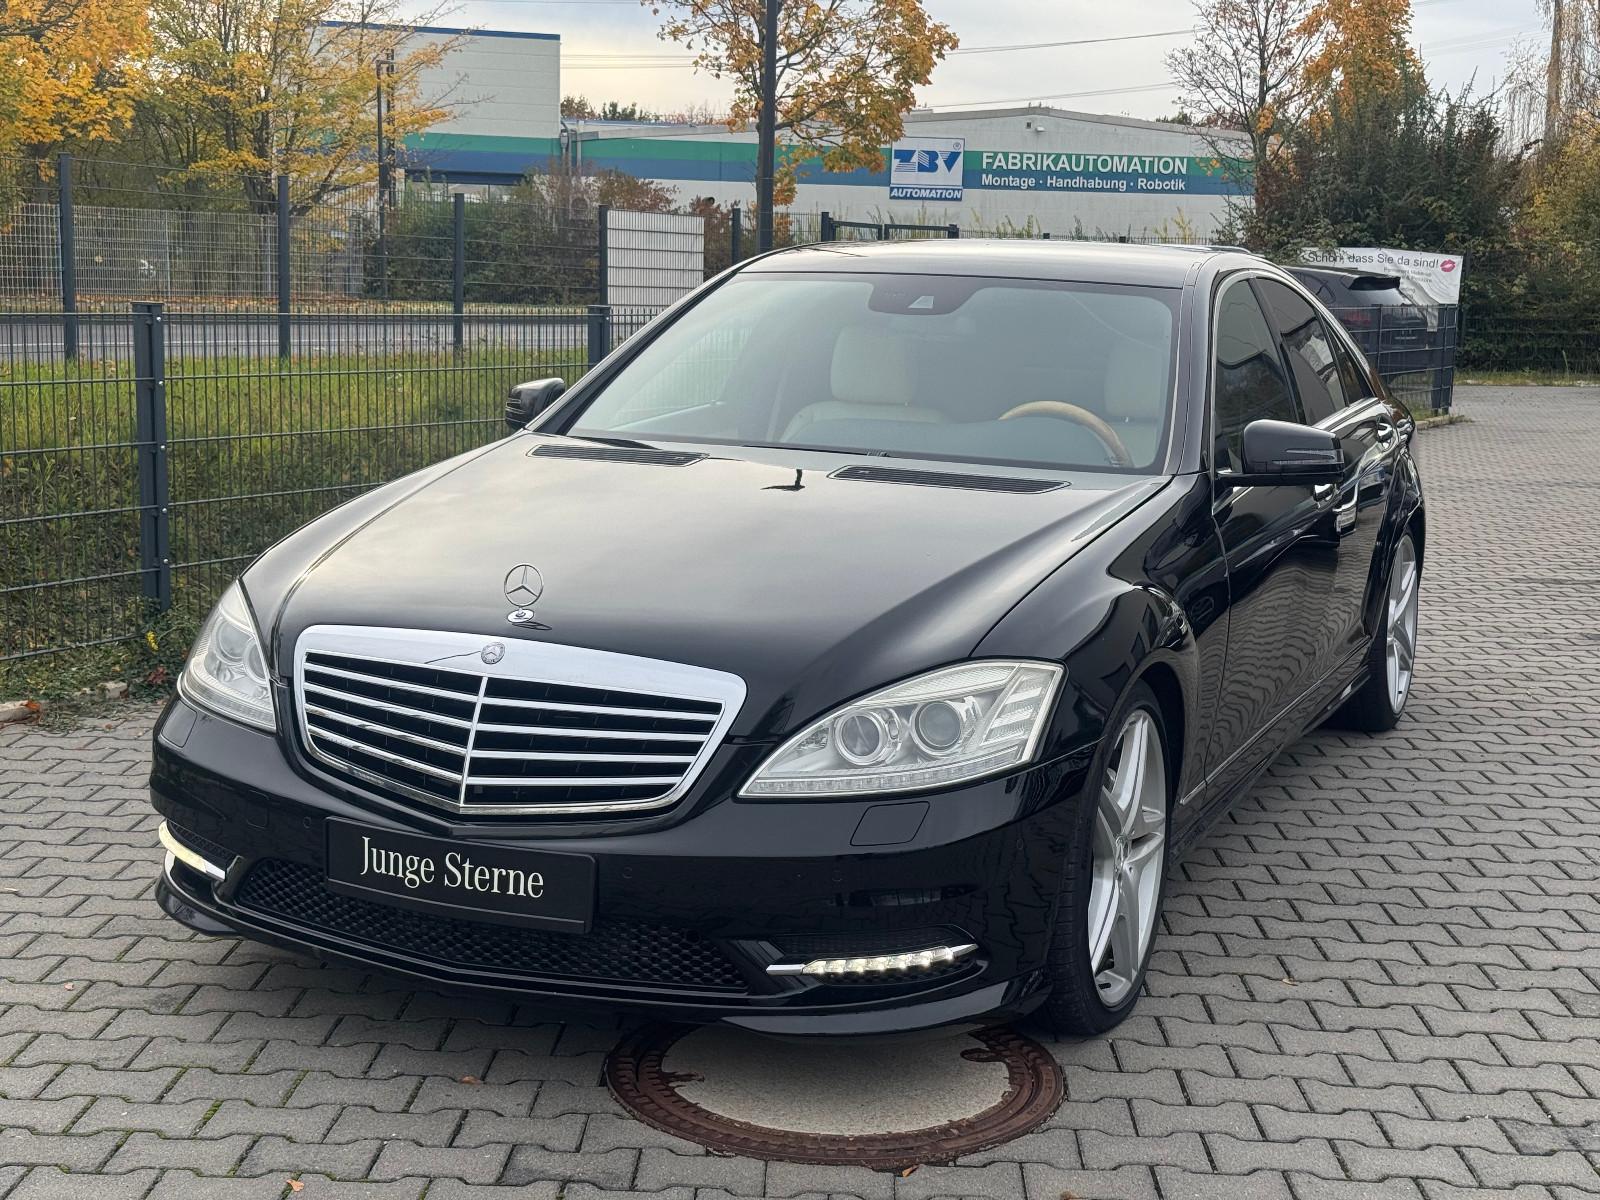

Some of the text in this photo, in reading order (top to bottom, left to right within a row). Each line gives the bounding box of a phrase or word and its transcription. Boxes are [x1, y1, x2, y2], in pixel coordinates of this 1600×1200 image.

[894, 150, 962, 173] ZBV
[981, 152, 1187, 175] FABRIKAUTOMATION
[981, 174, 1186, 191] Montage Handhabung Robotik
[890, 188, 962, 199] AUTOMATION
[1348, 253, 1374, 264] dass
[1377, 253, 1394, 265] Sie
[1397, 255, 1410, 266] da
[1413, 258, 1439, 269] sind!
[360, 836, 544, 899] Junge Sterne
